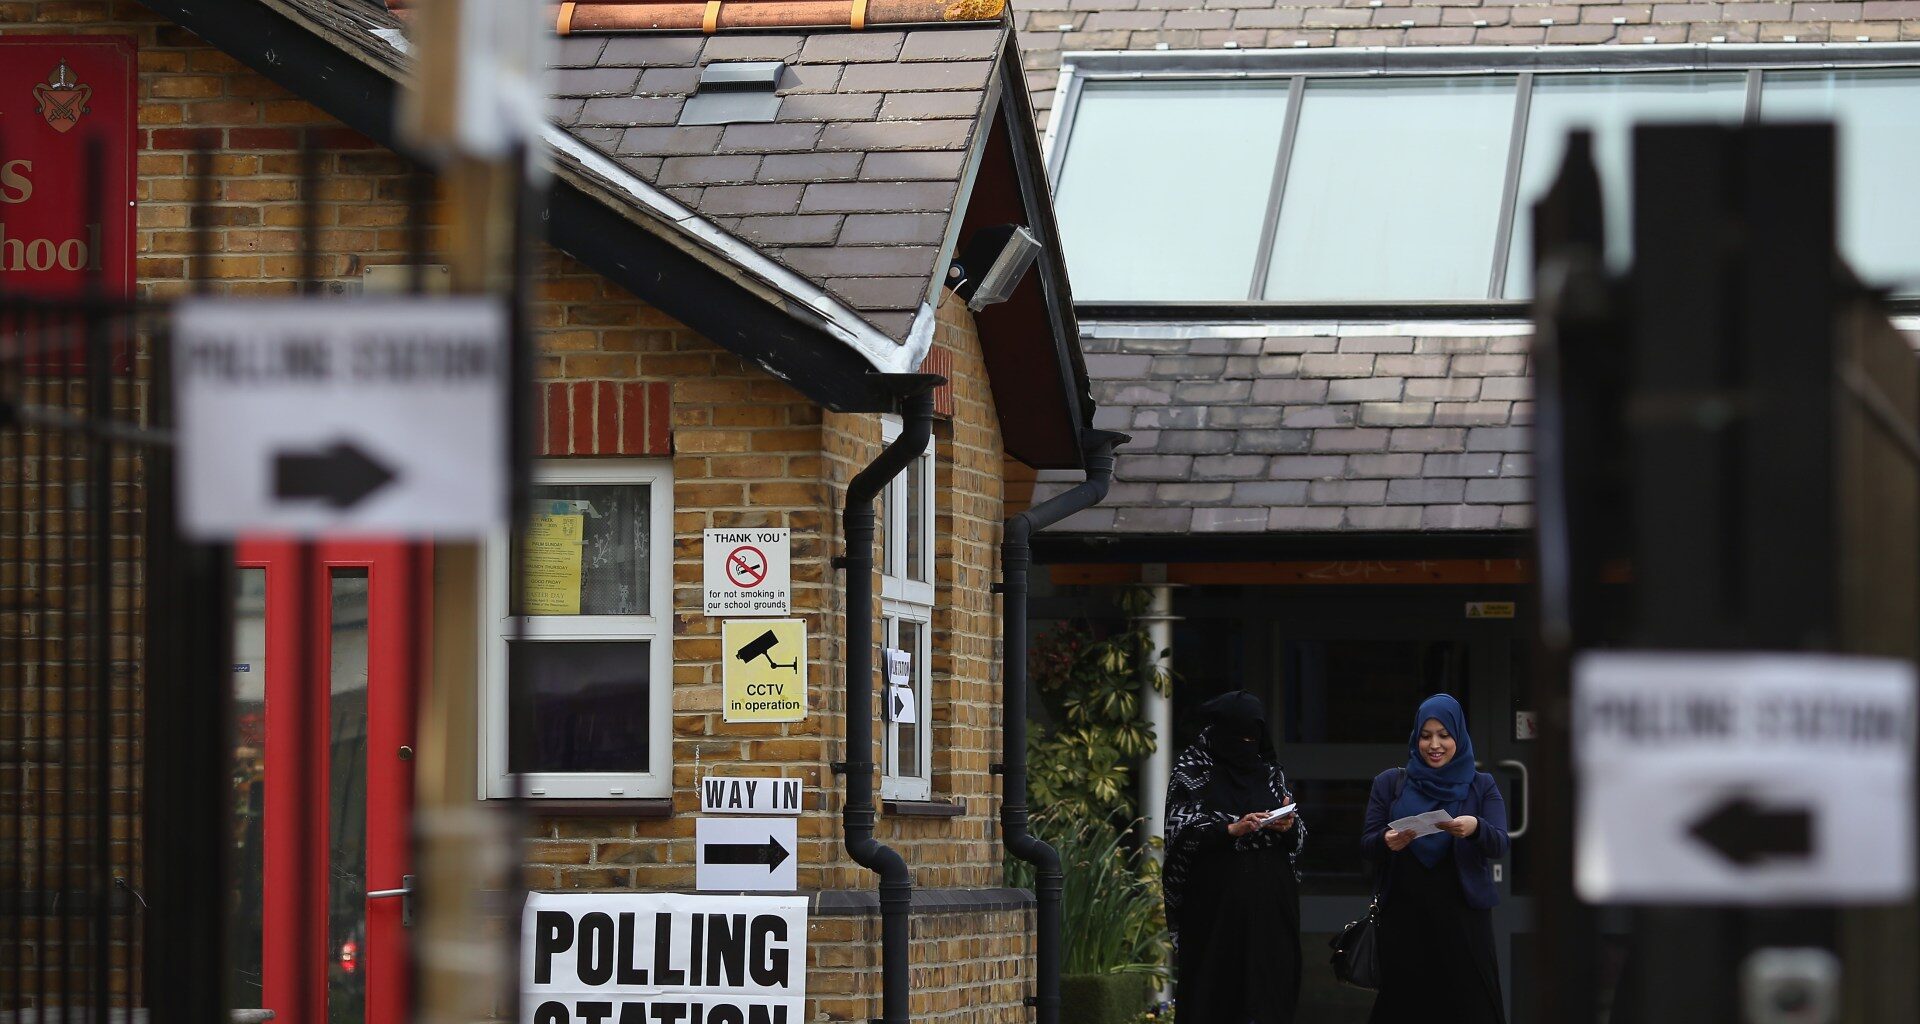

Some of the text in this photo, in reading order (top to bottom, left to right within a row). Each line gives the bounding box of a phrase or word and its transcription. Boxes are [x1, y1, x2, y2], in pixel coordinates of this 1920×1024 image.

[714, 533, 780, 543] THANK YOU
[709, 589, 785, 599] for not smoking in
[707, 600, 787, 610] our school grounds
[746, 683, 784, 696] CCTV
[731, 699, 800, 713] in operation
[704, 780, 799, 809] WAY IN
[534, 910, 790, 989] POLLING
